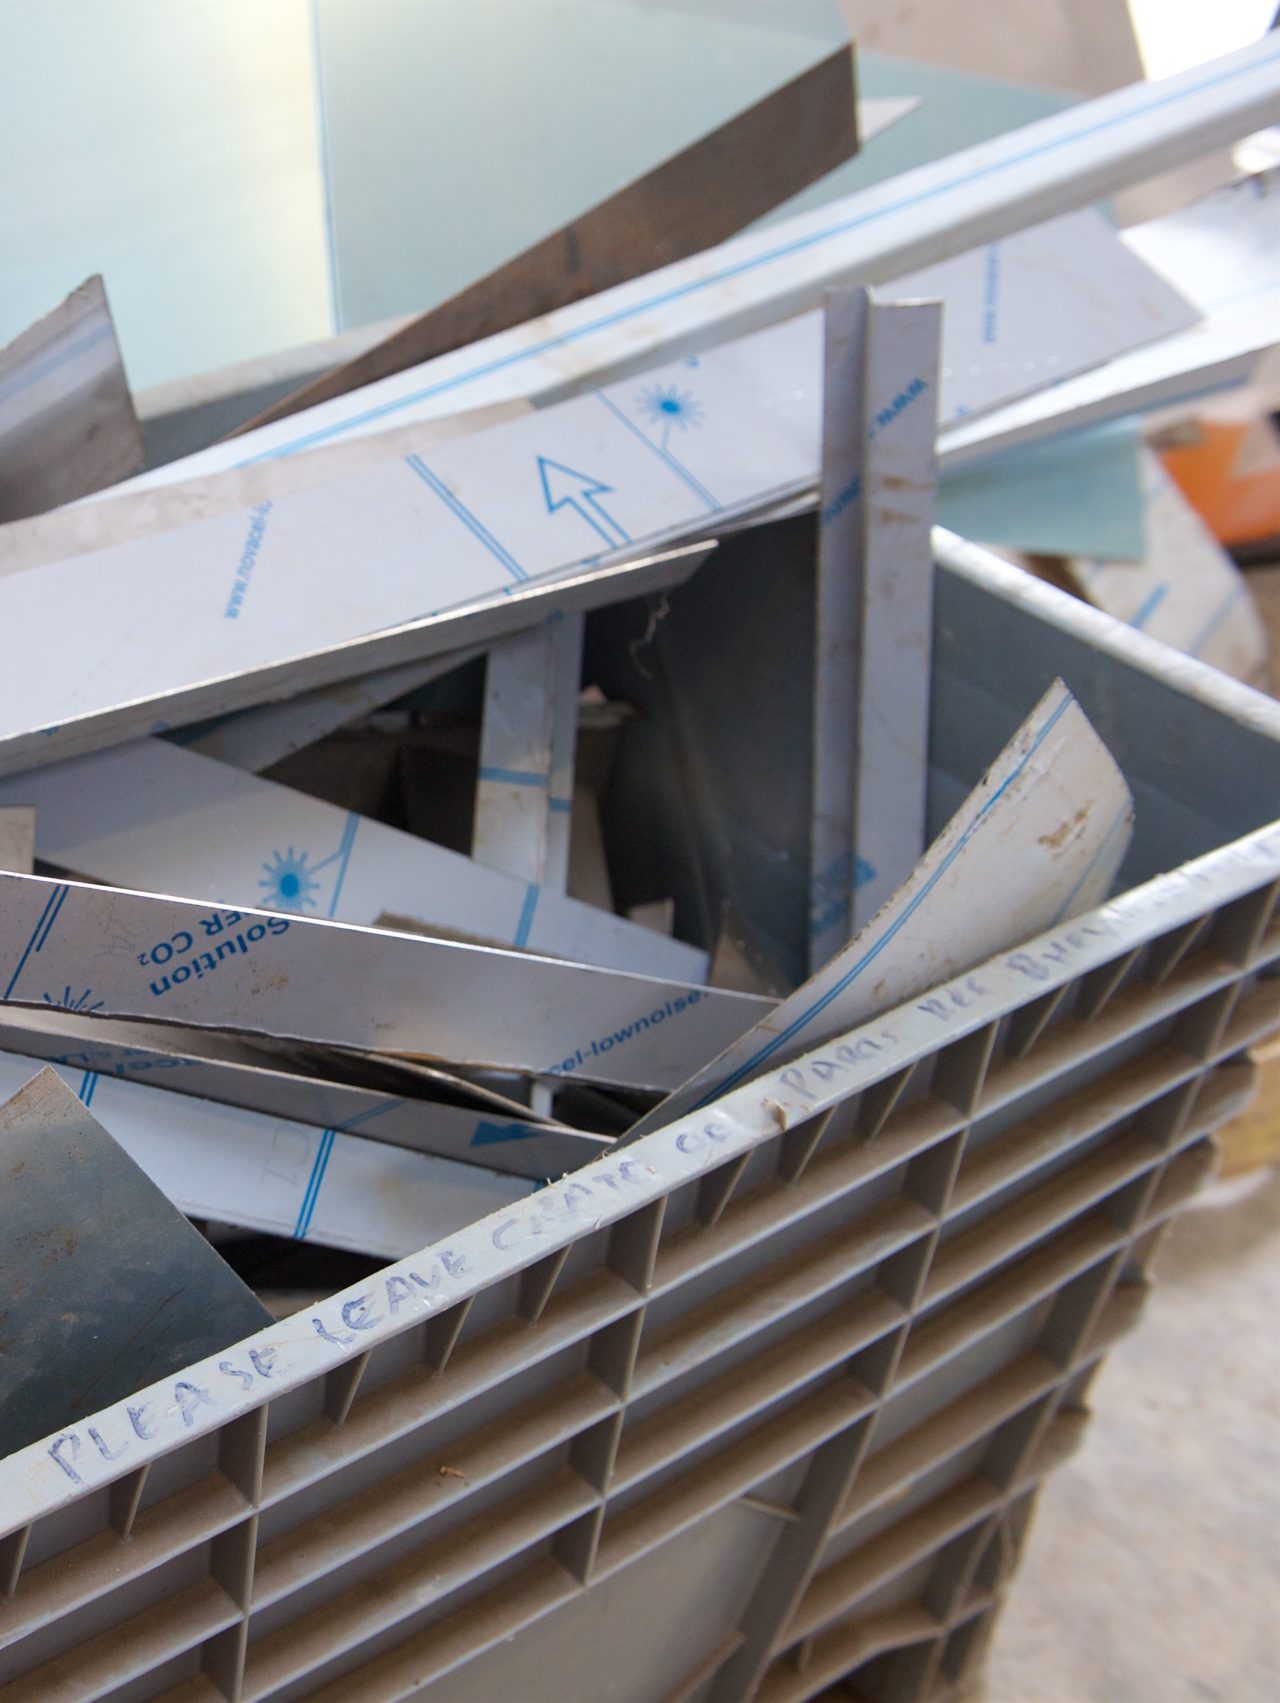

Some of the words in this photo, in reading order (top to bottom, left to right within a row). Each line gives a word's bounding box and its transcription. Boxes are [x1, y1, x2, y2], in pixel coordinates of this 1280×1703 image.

[150, 916, 291, 996] Solution
[47, 1346, 278, 1484] PLEASE
[312, 1250, 475, 1345] LEAVE
